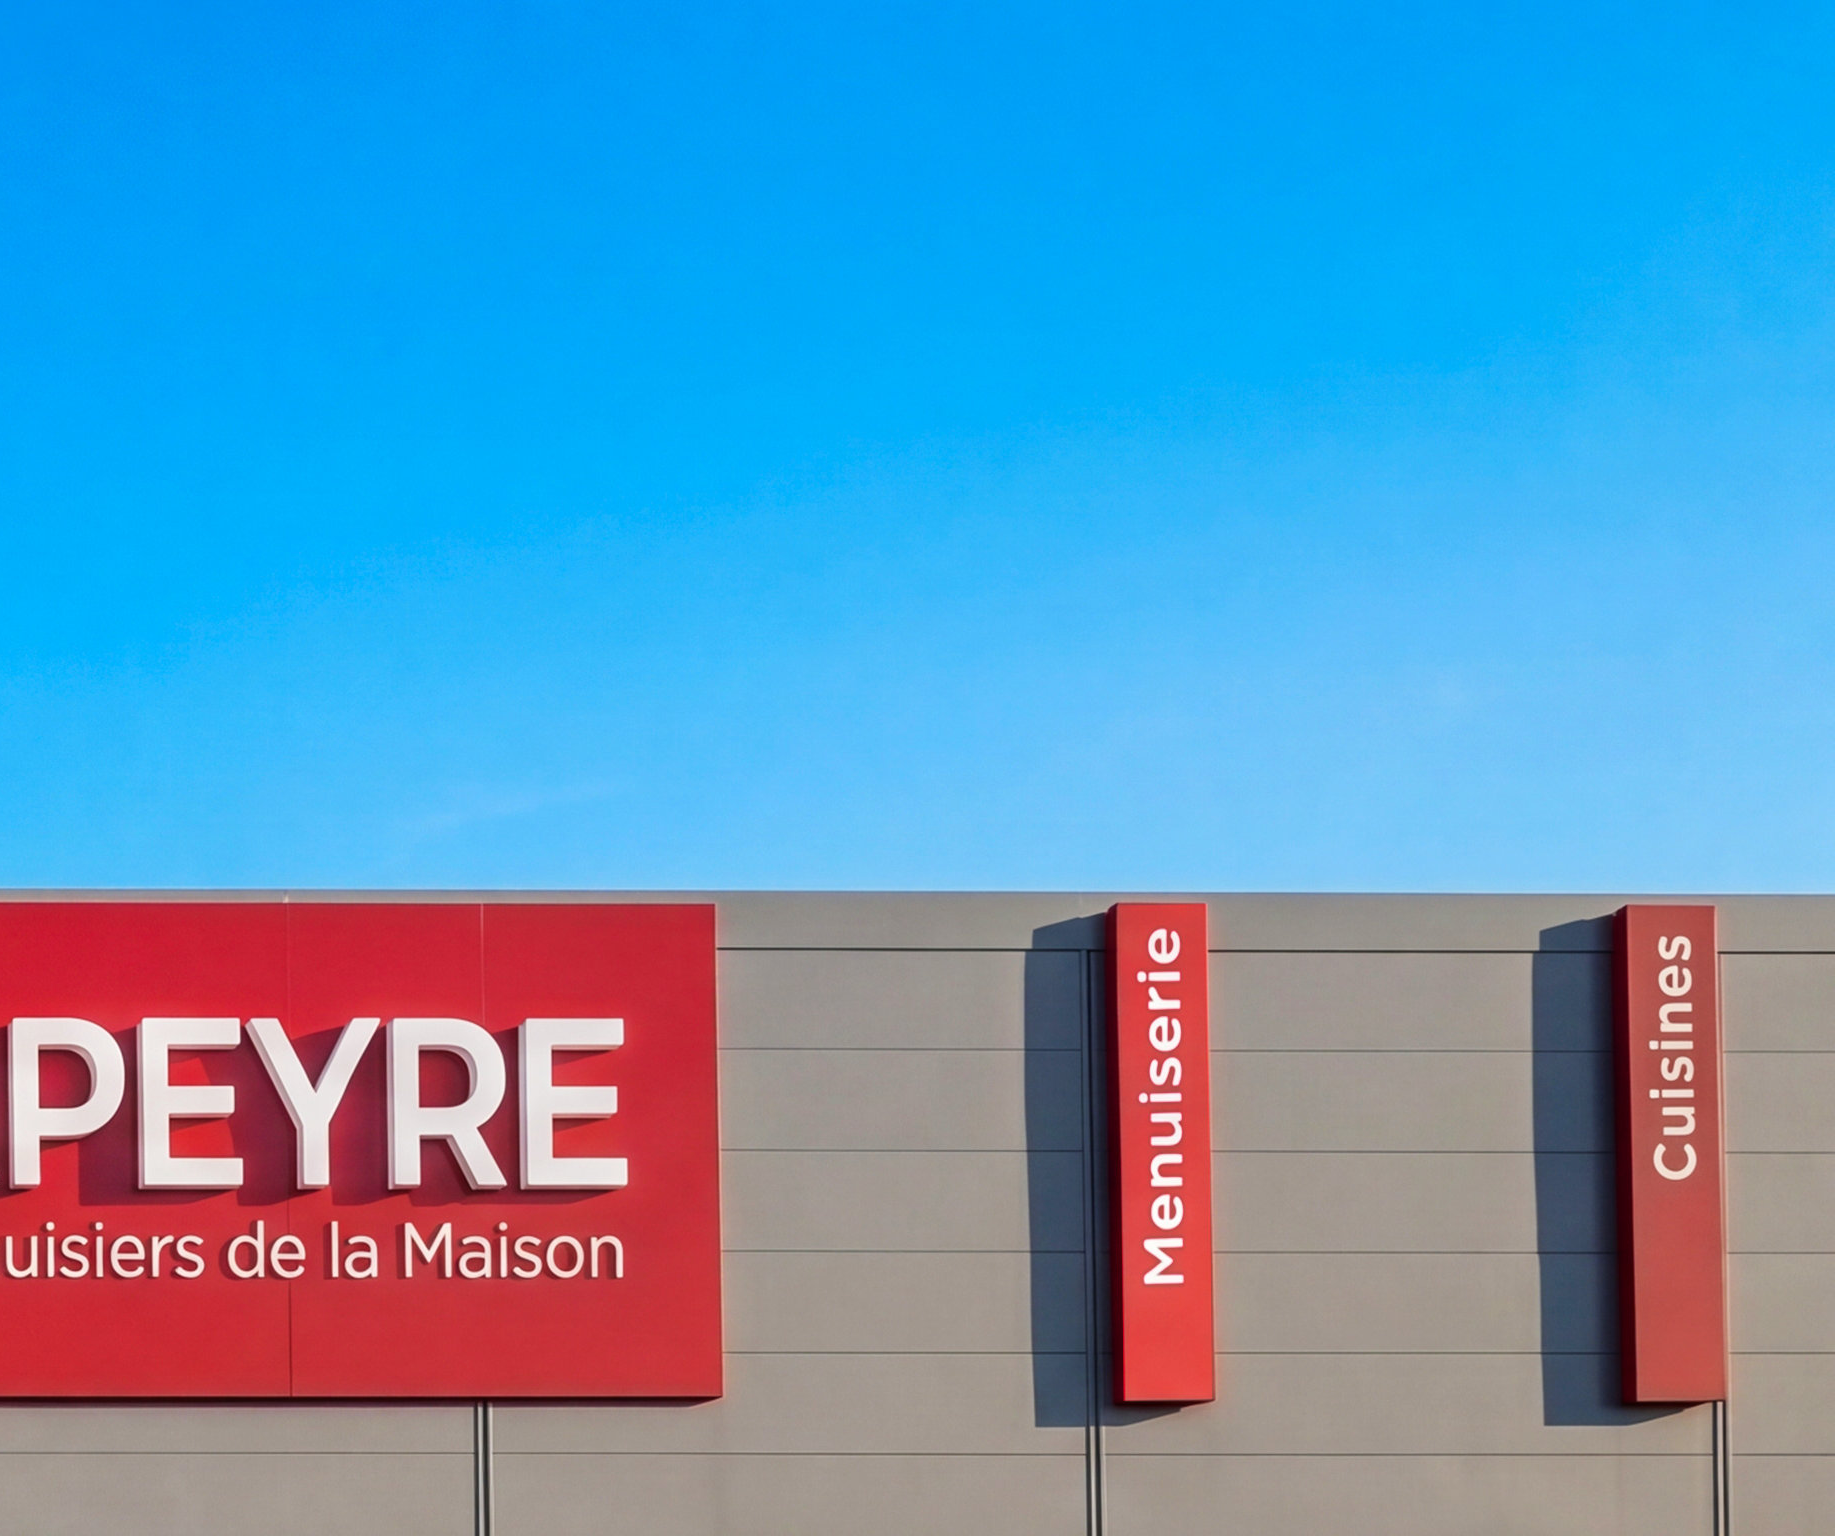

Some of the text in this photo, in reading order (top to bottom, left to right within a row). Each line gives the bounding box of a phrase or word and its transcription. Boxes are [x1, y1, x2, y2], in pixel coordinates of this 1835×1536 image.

[1137, 927, 1185, 1286] Menuiserie
[1648, 934, 1697, 1182] Cuisines
[226, 1219, 307, 1279] de
[330, 1220, 380, 1279] la
[402, 1221, 625, 1280] Maison
